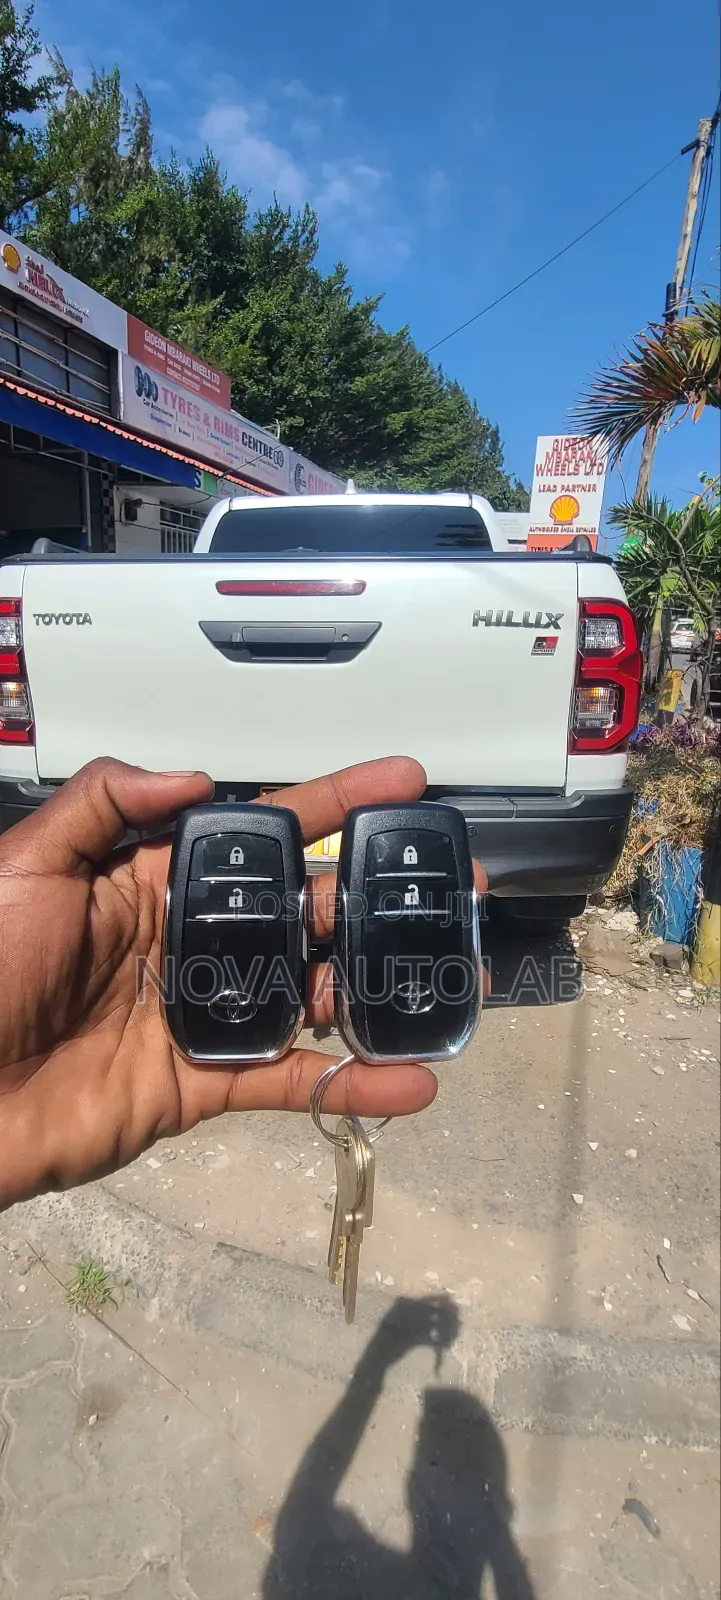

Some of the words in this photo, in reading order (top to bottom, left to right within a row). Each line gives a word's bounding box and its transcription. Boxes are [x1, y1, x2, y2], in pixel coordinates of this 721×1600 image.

[145, 329, 167, 353] GIDEON
[167, 343, 192, 369] MBARAKI
[192, 359, 211, 380] WHEELS
[211, 374, 220, 386] LTD
[143, 398, 151, 407] Car
[151, 402, 175, 419] Accessories
[162, 387, 200, 422] TYRES
[203, 413, 211, 427] &
[213, 416, 240, 443] RIMS
[242, 431, 272, 460] CENTRE
[552, 437, 593, 451] GIDEON
[545, 449, 596, 464] MBARAK
[536, 462, 580, 477] WHEELS
[584, 460, 605, 476] LTD
[538, 484, 558, 493] LEAD
[560, 483, 597, 493] PARTNER
[560, 526, 574, 534] SHELL
[575, 526, 597, 534] RETAILER
[33, 612, 93, 626] TOYOTA
[472, 609, 565, 630] HILUX
